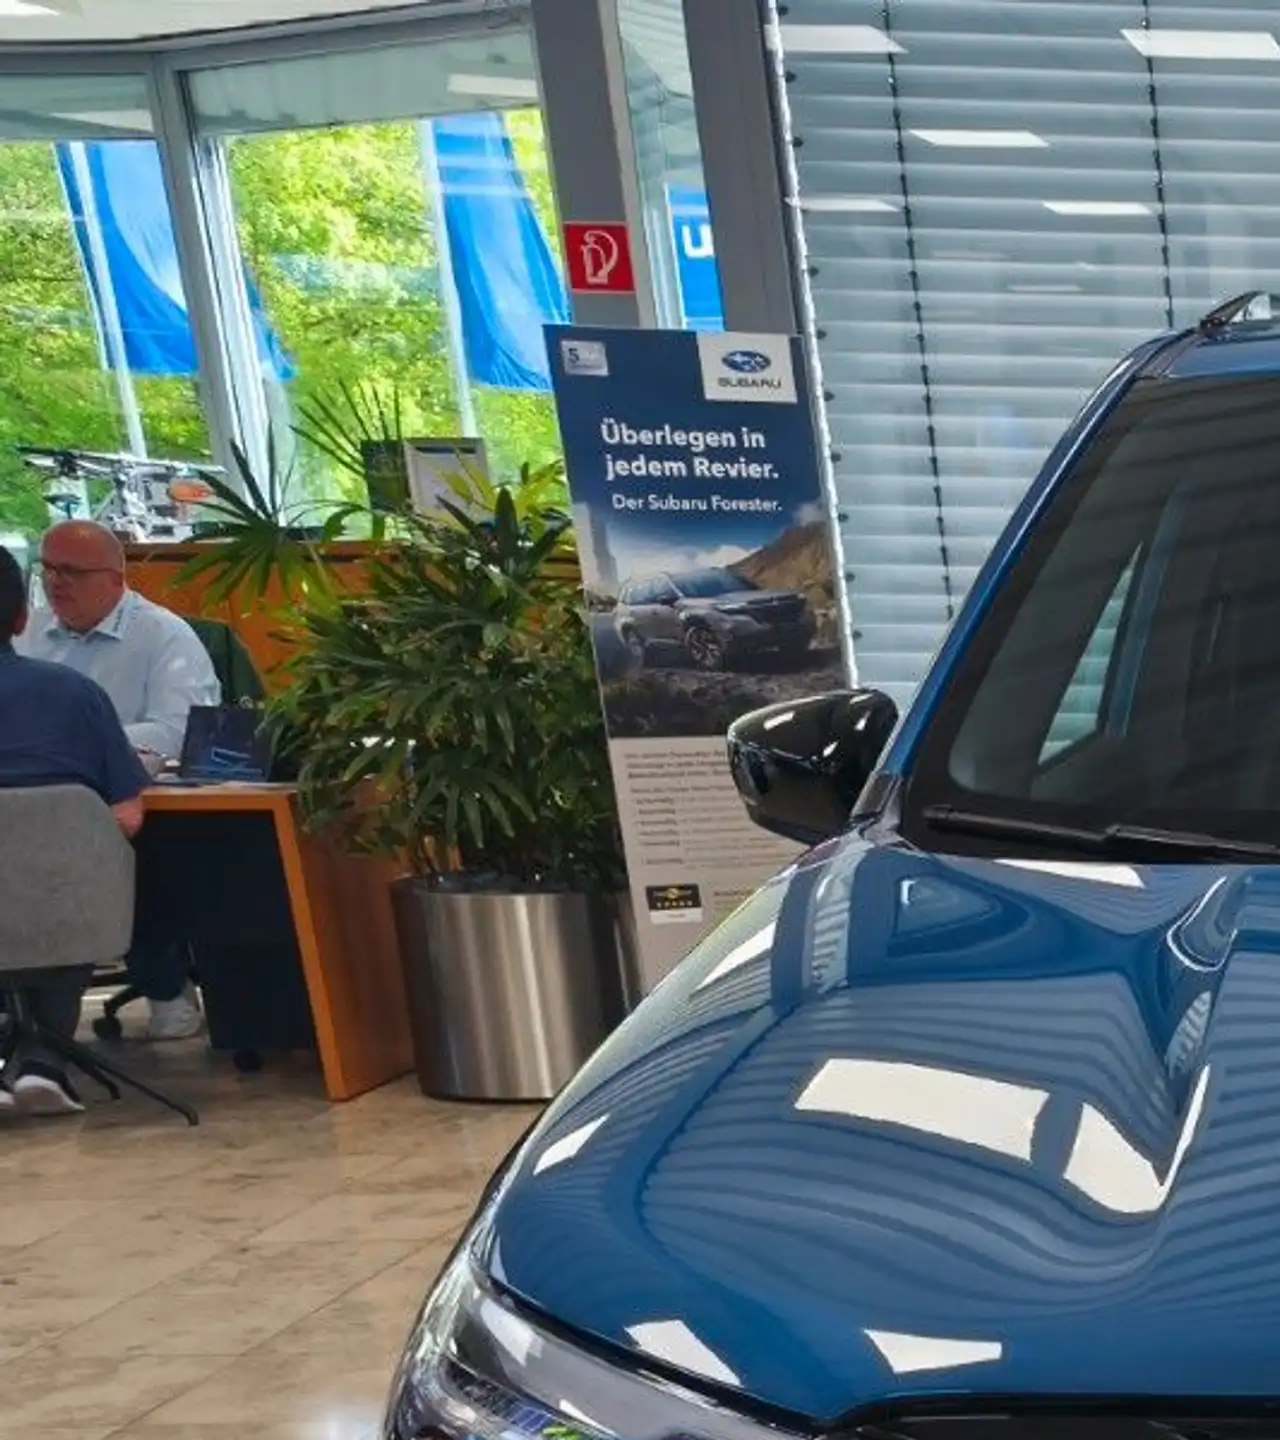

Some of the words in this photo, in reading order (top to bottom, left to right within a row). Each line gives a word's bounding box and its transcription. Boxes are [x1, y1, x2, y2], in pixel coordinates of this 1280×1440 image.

[718, 377, 781, 389] SUBARU
[601, 418, 736, 452] Überlegen
[741, 427, 765, 448] in
[605, 454, 687, 481] jedem
[694, 458, 779, 479] Revier.
[612, 494, 644, 510] Der
[649, 496, 707, 511] Subaru
[712, 497, 782, 512] Forester.
